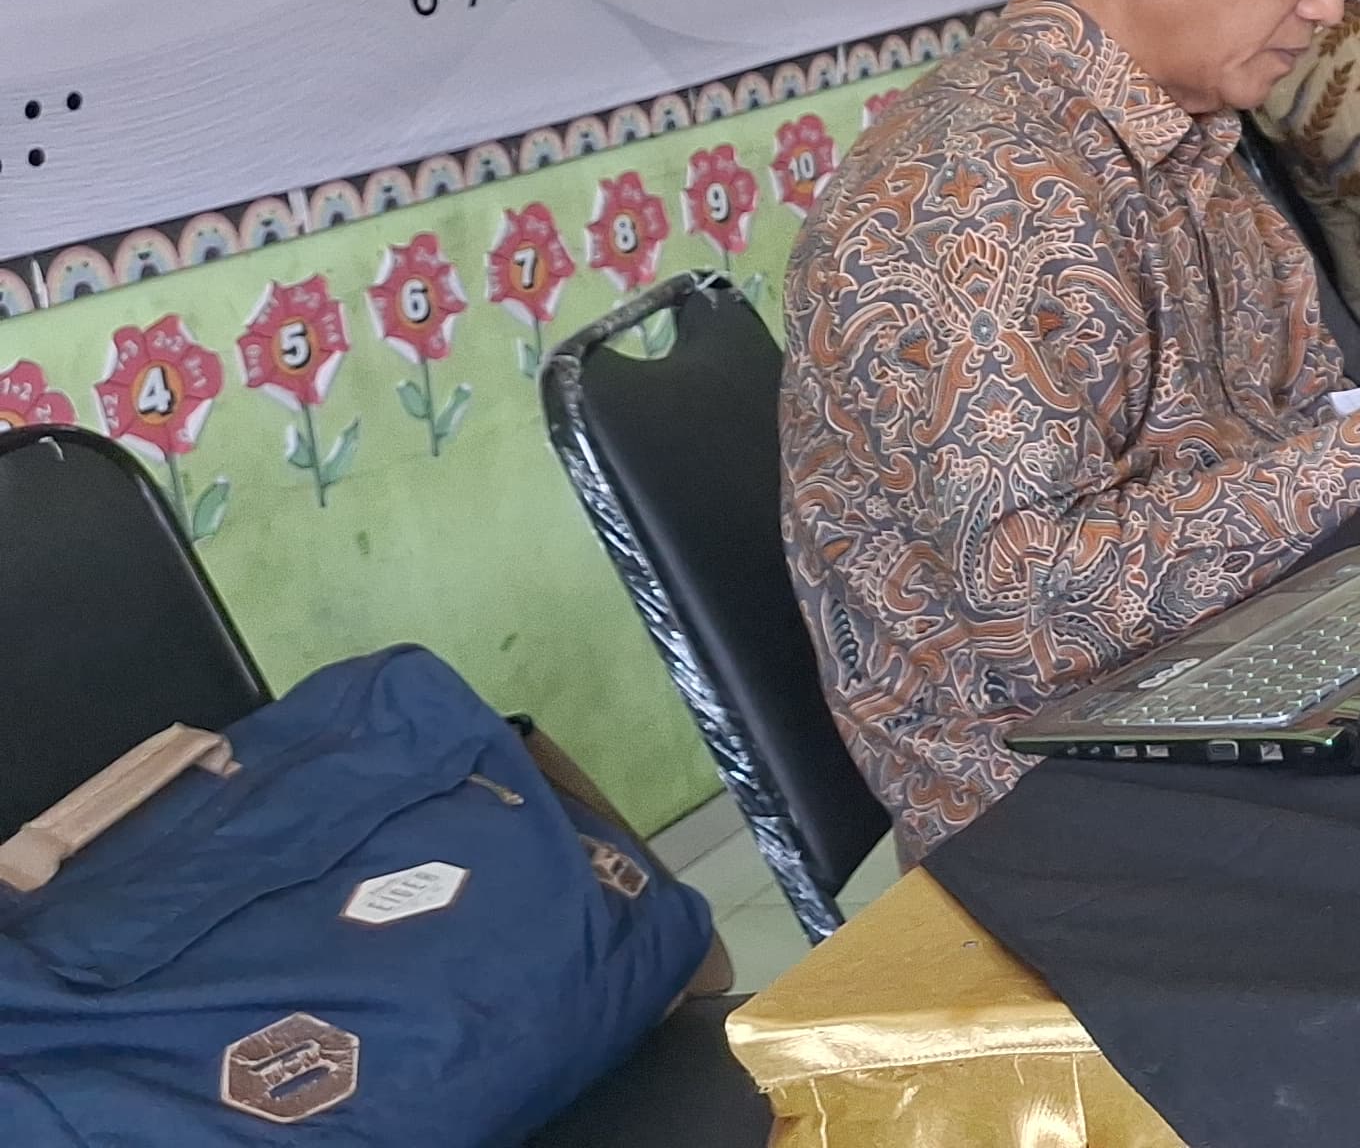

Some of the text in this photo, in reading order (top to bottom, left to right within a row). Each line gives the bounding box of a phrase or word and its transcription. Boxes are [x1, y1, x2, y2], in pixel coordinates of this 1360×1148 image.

[137, 365, 178, 416] 4
[279, 321, 312, 370] 5
[402, 278, 433, 324] 6
[513, 246, 539, 290] 7
[614, 213, 639, 254] 8
[705, 182, 730, 222] 9
[788, 150, 816, 182] 10
